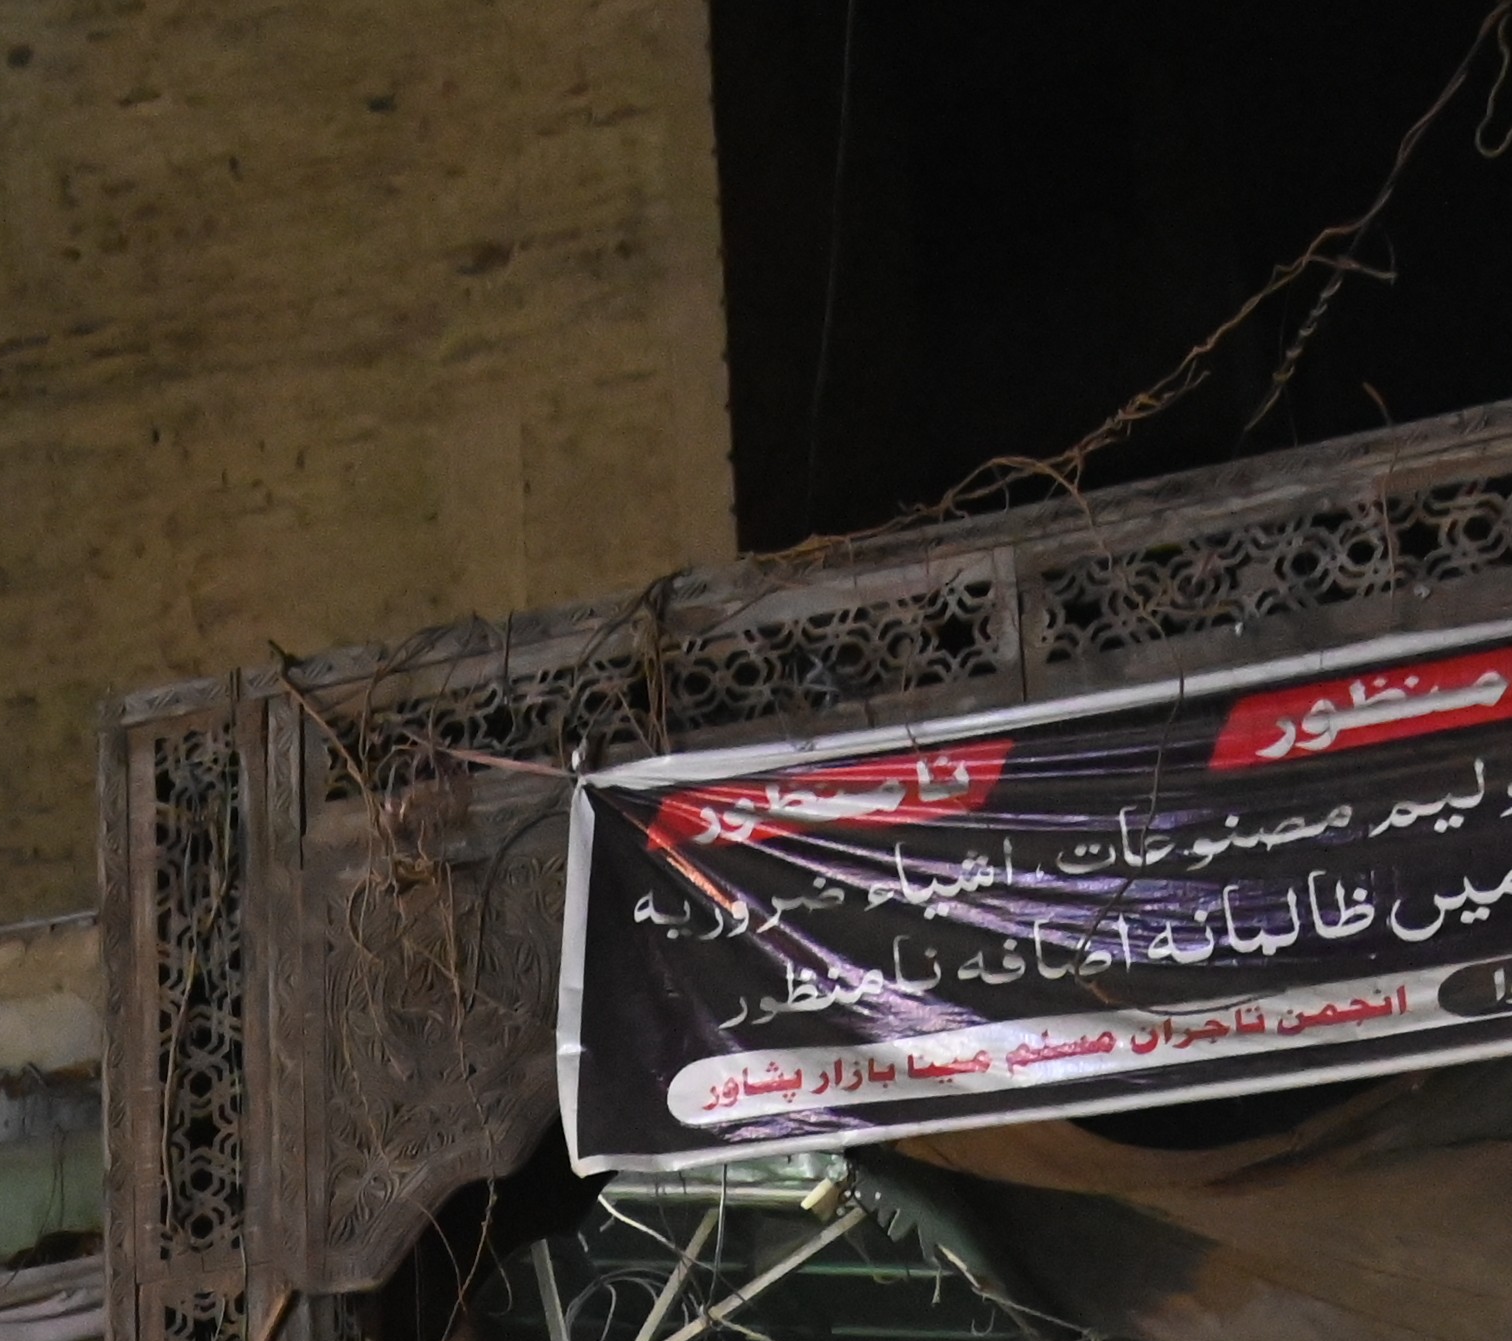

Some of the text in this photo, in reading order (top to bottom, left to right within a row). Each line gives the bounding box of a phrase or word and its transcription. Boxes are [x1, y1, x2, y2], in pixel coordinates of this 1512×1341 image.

[693, 755, 970, 845] نامنظور
[1148, 867, 1377, 965] ظالمانہ
[718, 933, 943, 1030] نامنظور
[1130, 1004, 1268, 1054] تاجران
[1277, 985, 1408, 1037] انجمن
[703, 1060, 803, 1111] پشاور
[809, 1056, 897, 1095] بازار
